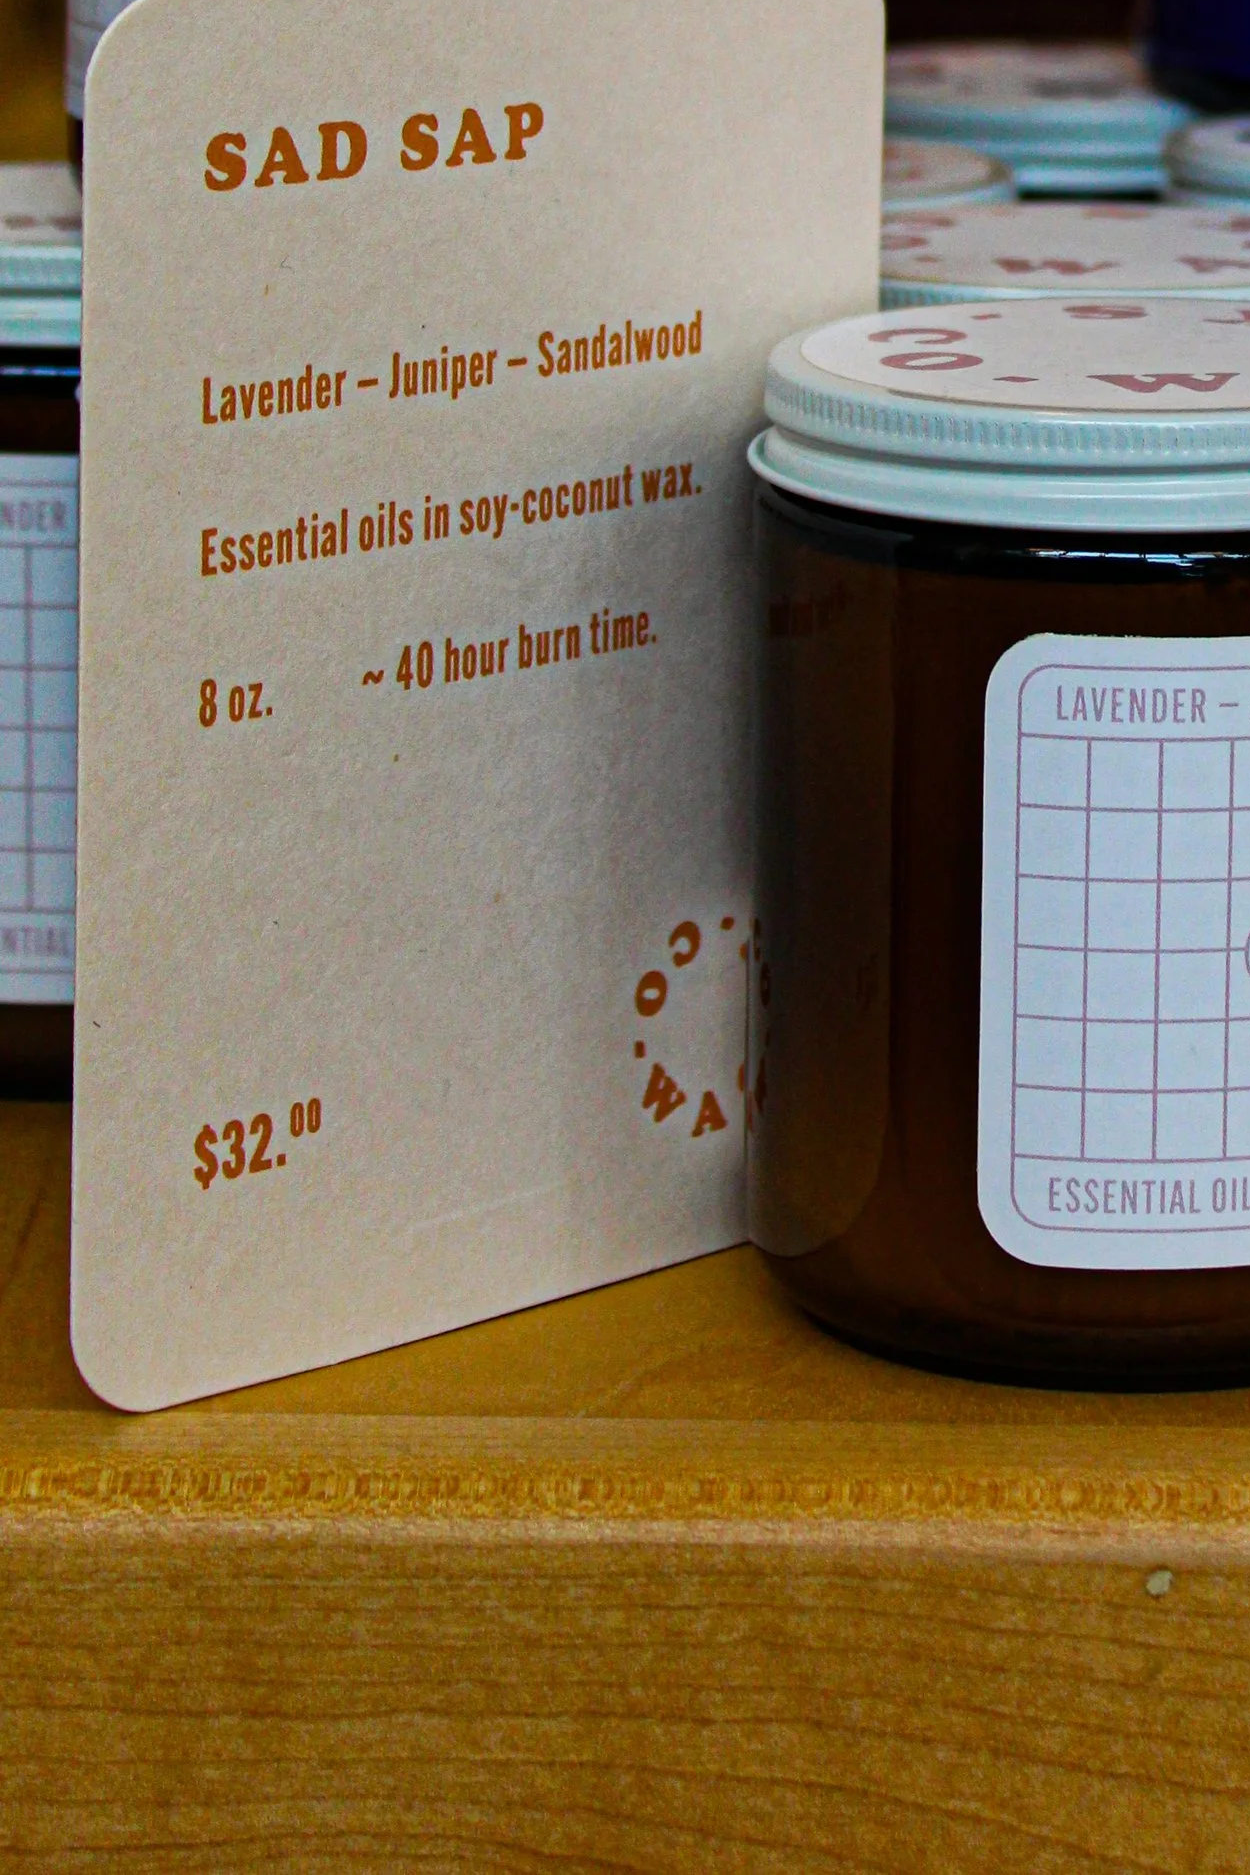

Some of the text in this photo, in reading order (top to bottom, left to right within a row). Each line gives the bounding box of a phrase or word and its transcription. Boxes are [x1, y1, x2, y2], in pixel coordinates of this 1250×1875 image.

[204, 101, 545, 191] SAD SAP
[201, 363, 347, 425] Lavender
[389, 345, 498, 400] Juniper
[537, 309, 704, 378] Sandalwood
[200, 461, 703, 577] Essential oils in soy-coconut wax.
[199, 677, 218, 728] 8
[228, 681, 275, 724] oz.
[396, 639, 434, 692] 40
[444, 636, 512, 685] hour
[518, 623, 581, 669] burn
[589, 607, 659, 655] time.
[1055, 684, 1207, 724] LAVENDER
[1048, 1176, 1202, 1215] ESSENTIAL
